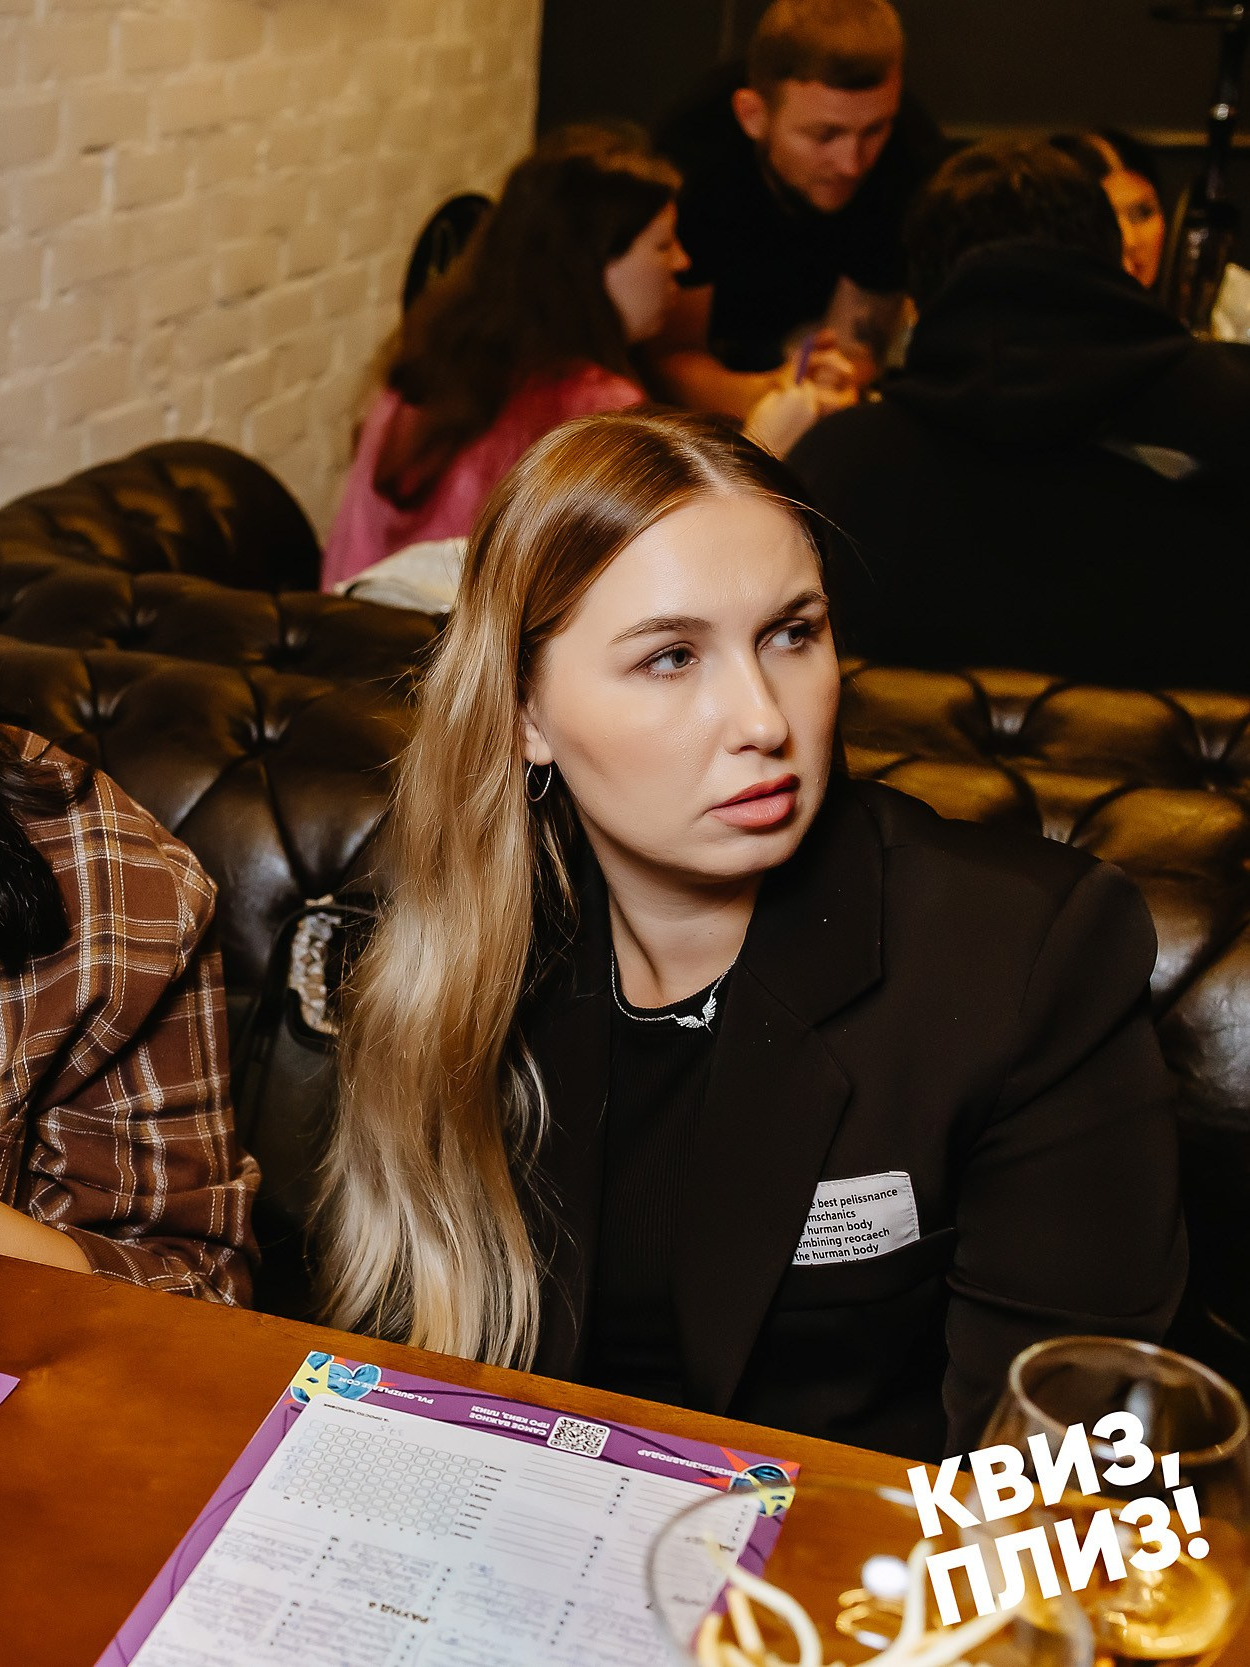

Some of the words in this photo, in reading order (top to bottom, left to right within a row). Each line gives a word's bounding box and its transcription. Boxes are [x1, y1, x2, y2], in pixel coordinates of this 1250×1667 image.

[817, 1198, 838, 1208] best
[840, 1188, 898, 1209] pelissnance
[807, 1225, 845, 1236] hurman
[846, 1219, 873, 1231] body
[844, 1227, 890, 1244] reocaech
[794, 1252, 810, 1261] the
[812, 1250, 851, 1260] hurman
[852, 1243, 879, 1255] body
